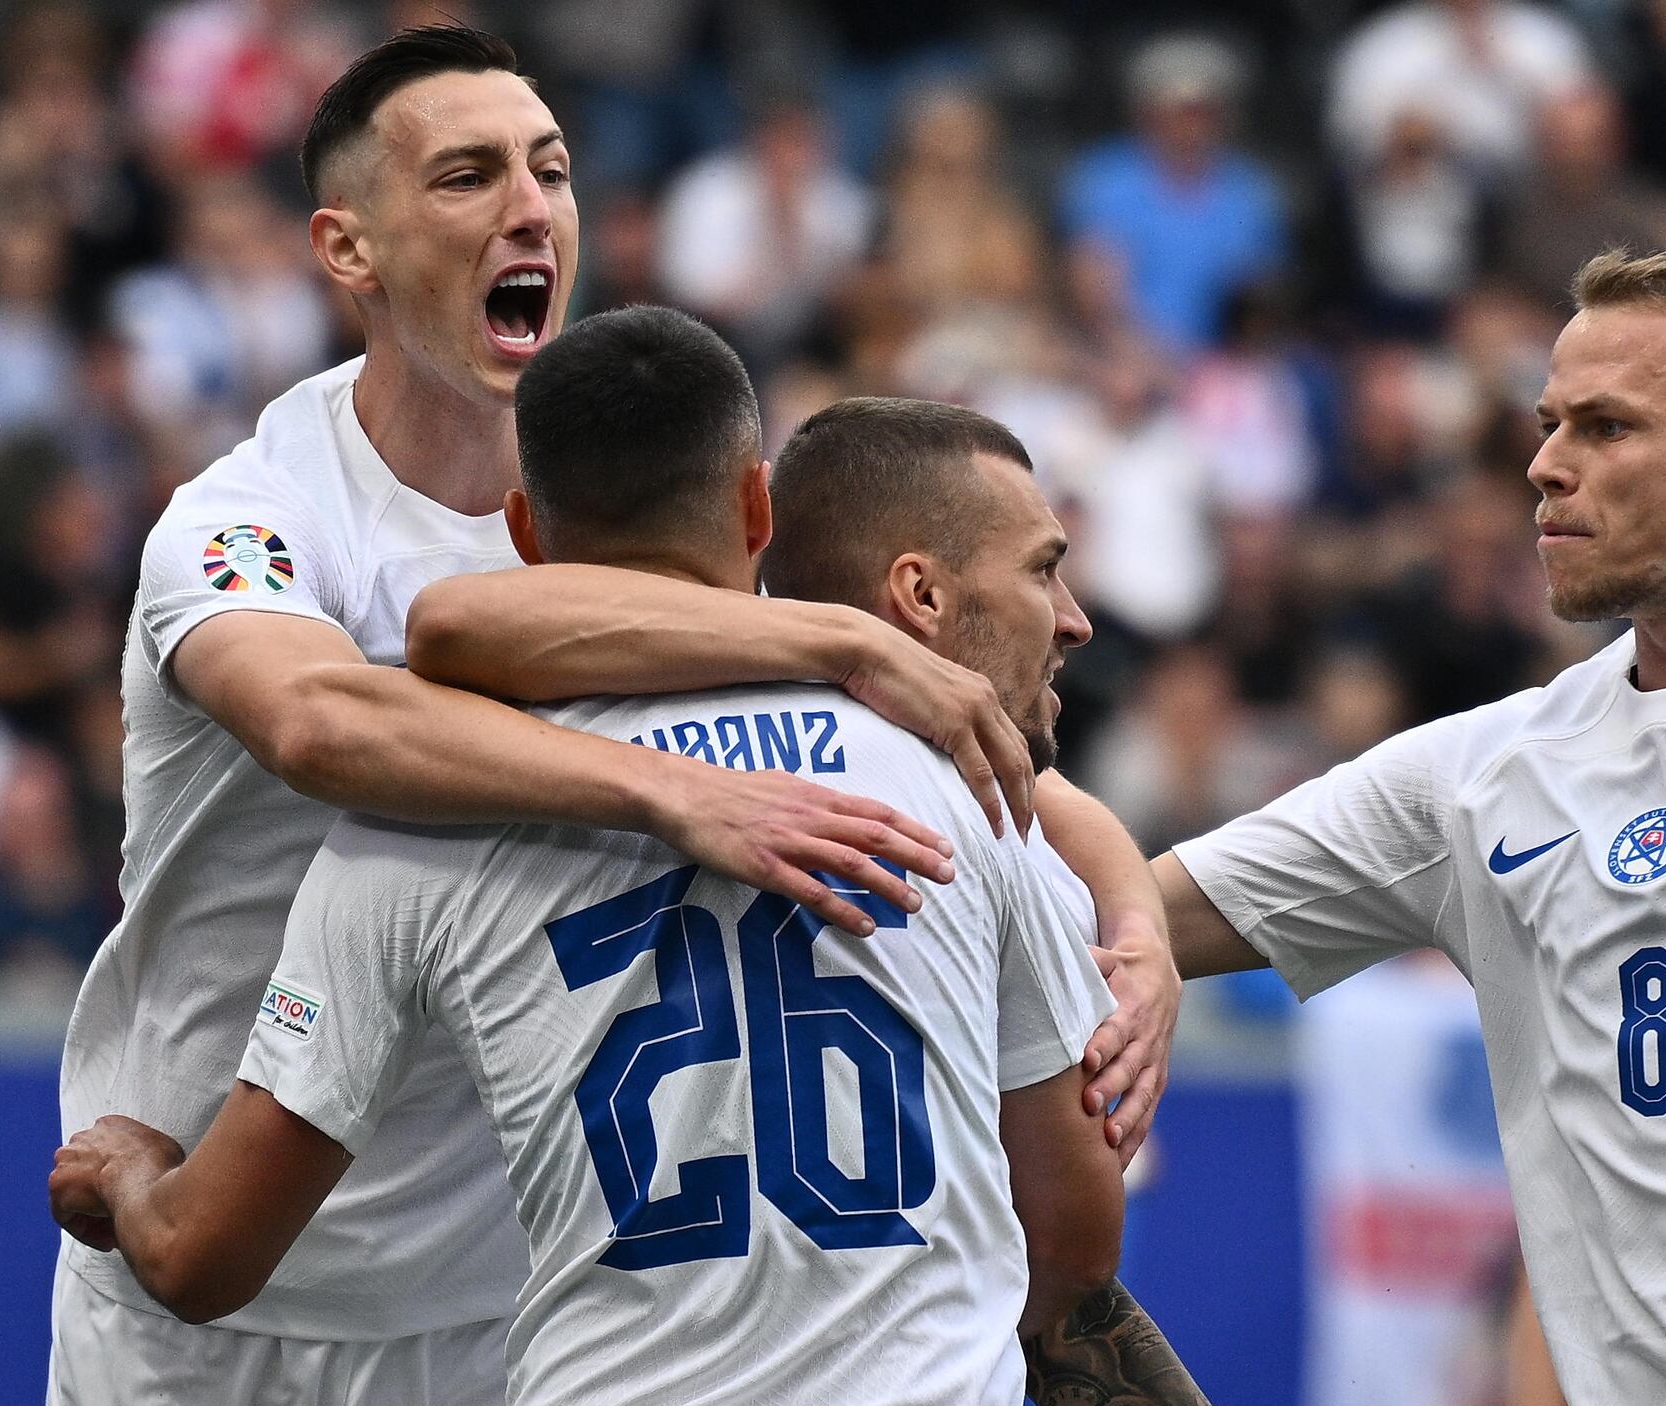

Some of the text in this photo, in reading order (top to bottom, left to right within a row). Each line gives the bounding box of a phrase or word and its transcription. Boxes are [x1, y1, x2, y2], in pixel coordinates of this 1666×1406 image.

[1628, 873, 1653, 883] SFZ
[263, 990, 318, 1025] ATION
[272, 1014, 309, 1037] for children
[543, 856, 937, 1271] 26
